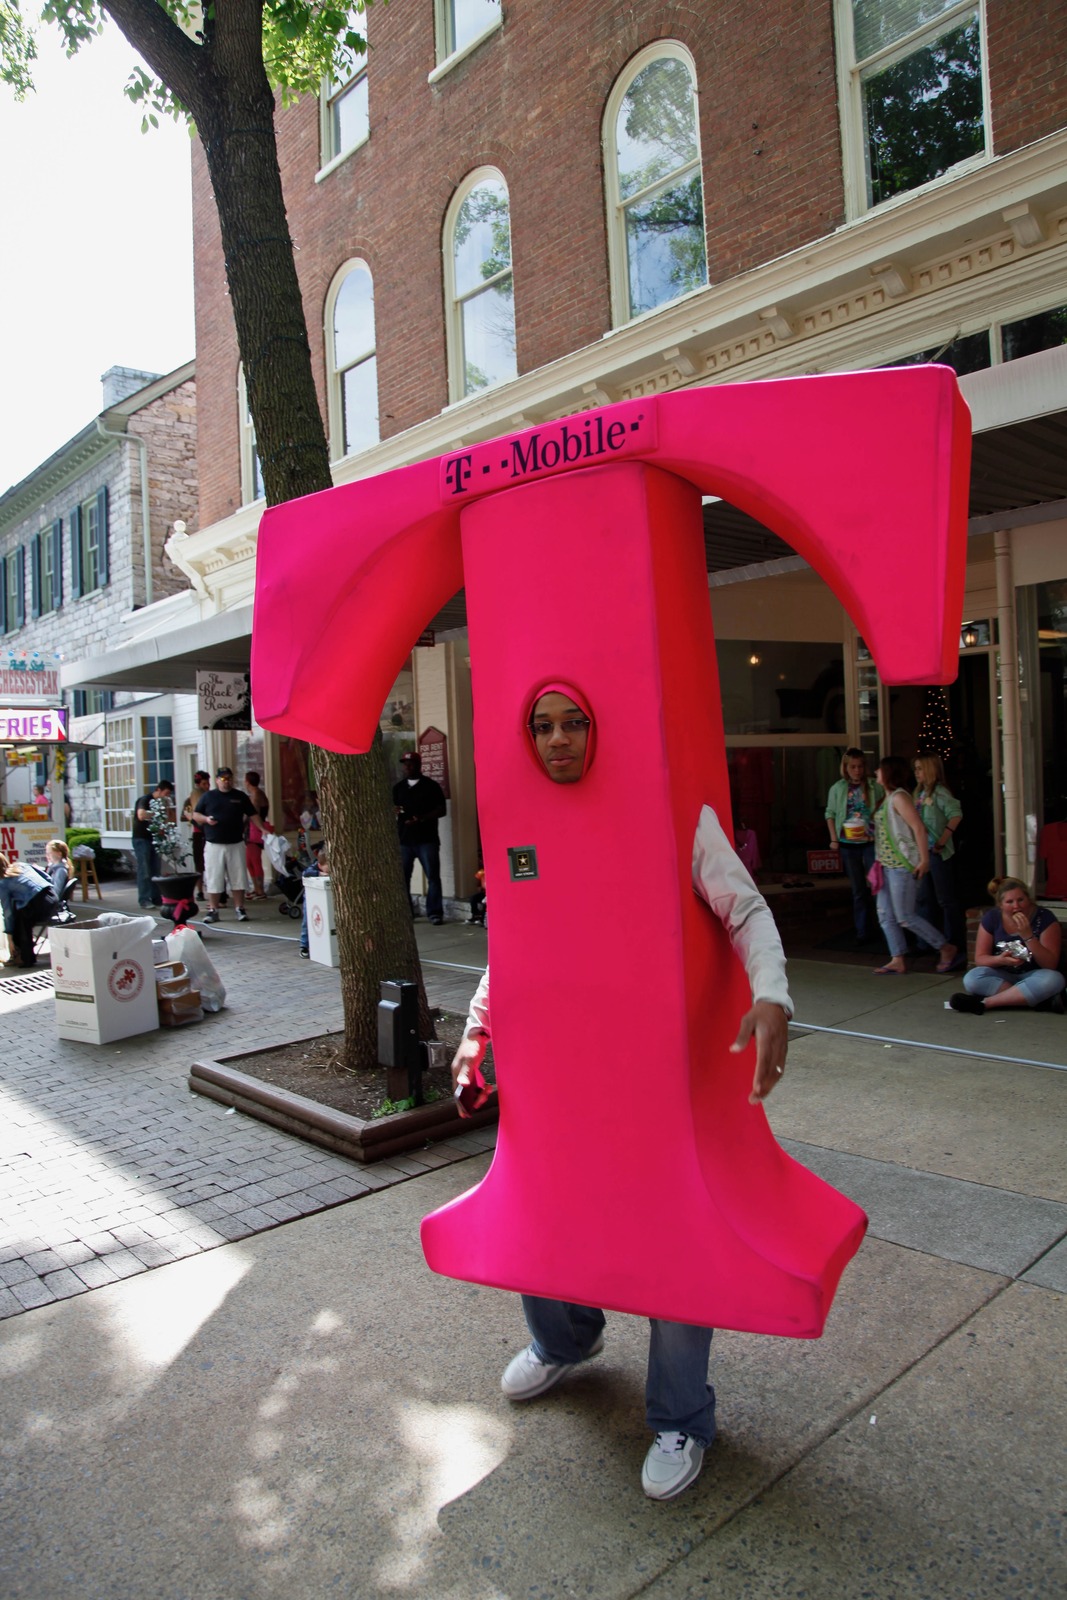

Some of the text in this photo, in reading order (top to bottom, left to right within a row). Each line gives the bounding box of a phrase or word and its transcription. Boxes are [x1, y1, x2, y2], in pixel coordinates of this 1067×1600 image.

[0, 669, 58, 695] CHEESESTEAK
[209, 673, 223, 684] The
[199, 682, 234, 697] Black
[204, 696, 235, 711] Rose
[420, 744, 430, 752] FOR
[421, 764, 431, 772] FOR
[811, 859, 839, 871] OPEN
